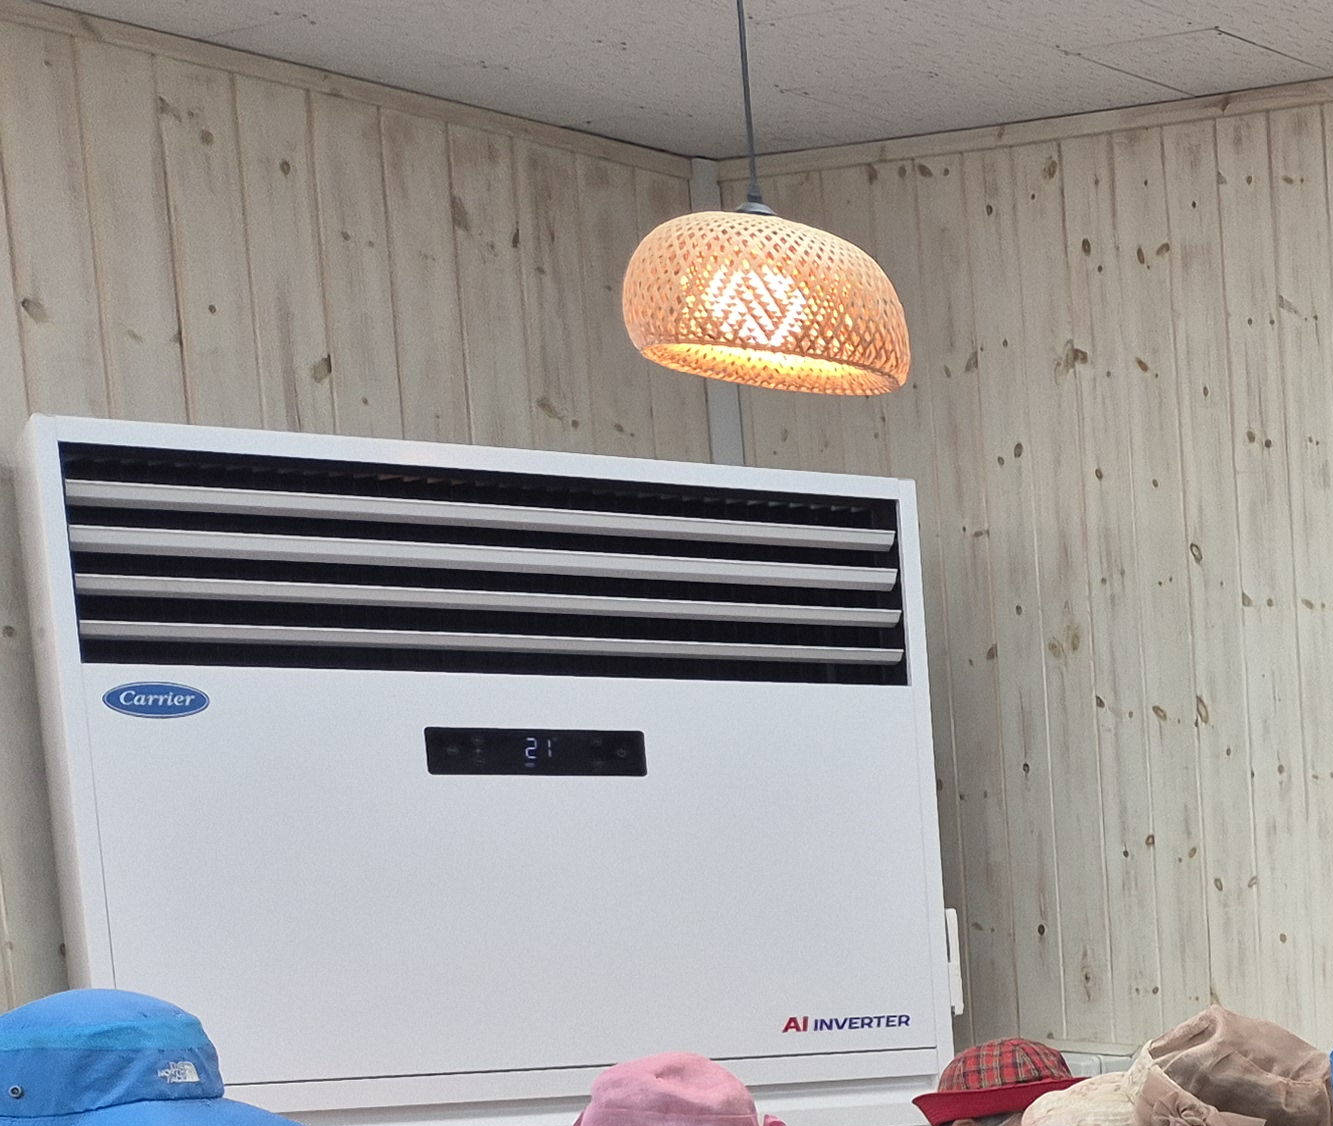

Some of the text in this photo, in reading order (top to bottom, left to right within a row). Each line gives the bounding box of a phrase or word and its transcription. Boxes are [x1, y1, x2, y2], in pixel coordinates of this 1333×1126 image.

[119, 690, 196, 707] Carrier
[525, 737, 552, 759] 21
[782, 1014, 910, 1033] AI INVERTER
